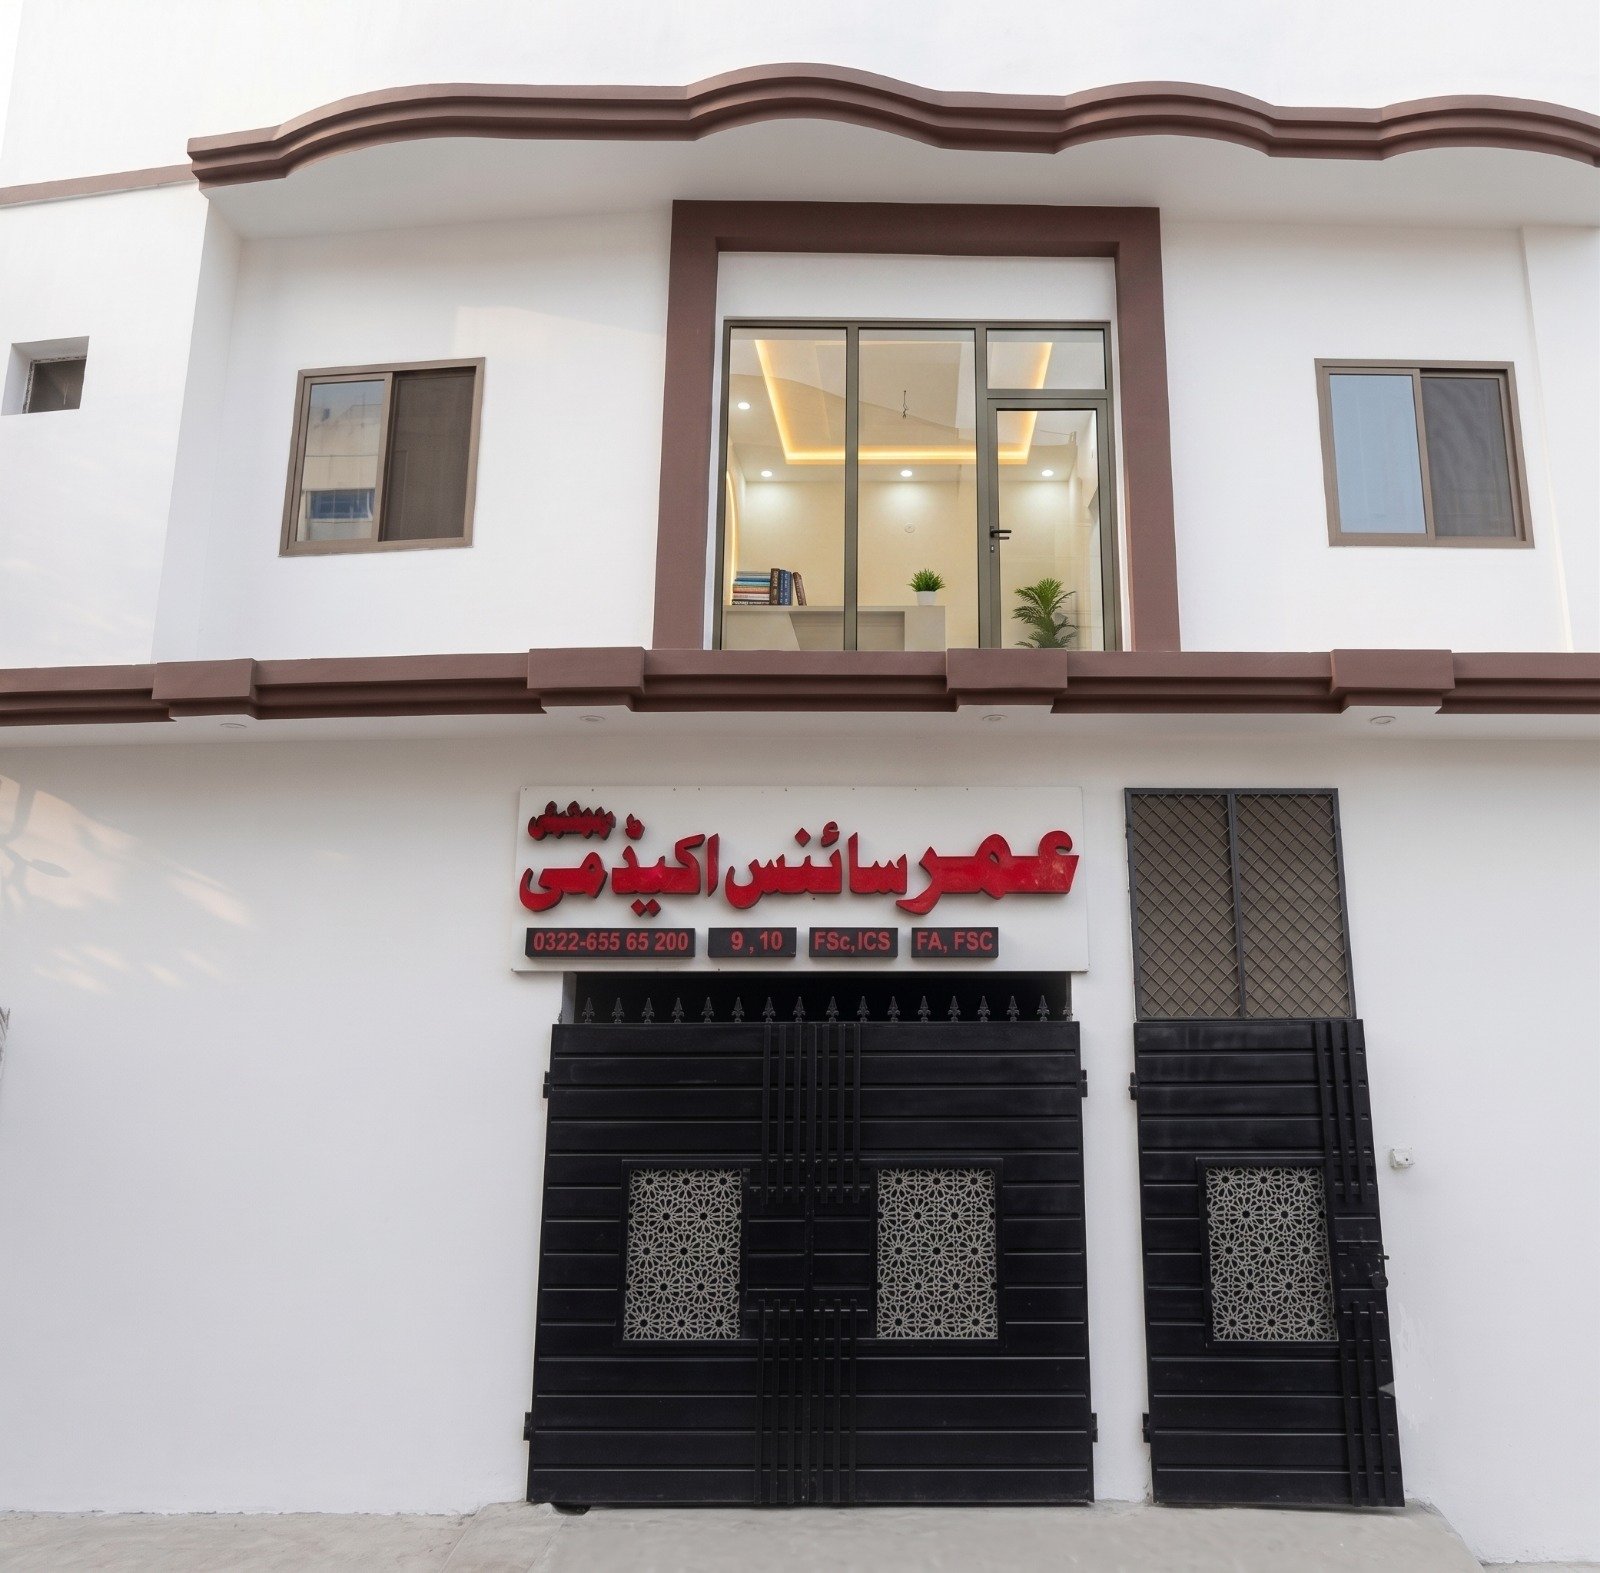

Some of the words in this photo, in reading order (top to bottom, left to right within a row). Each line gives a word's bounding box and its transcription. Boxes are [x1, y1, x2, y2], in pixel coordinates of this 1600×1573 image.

[724, 821, 908, 910] سائنس
[895, 829, 1081, 917] عمر
[533, 931, 621, 952] 0322-655
[625, 931, 649, 952] 65
[654, 931, 689, 952] 200
[759, 930, 783, 951] 10
[953, 931, 993, 951] FSC
